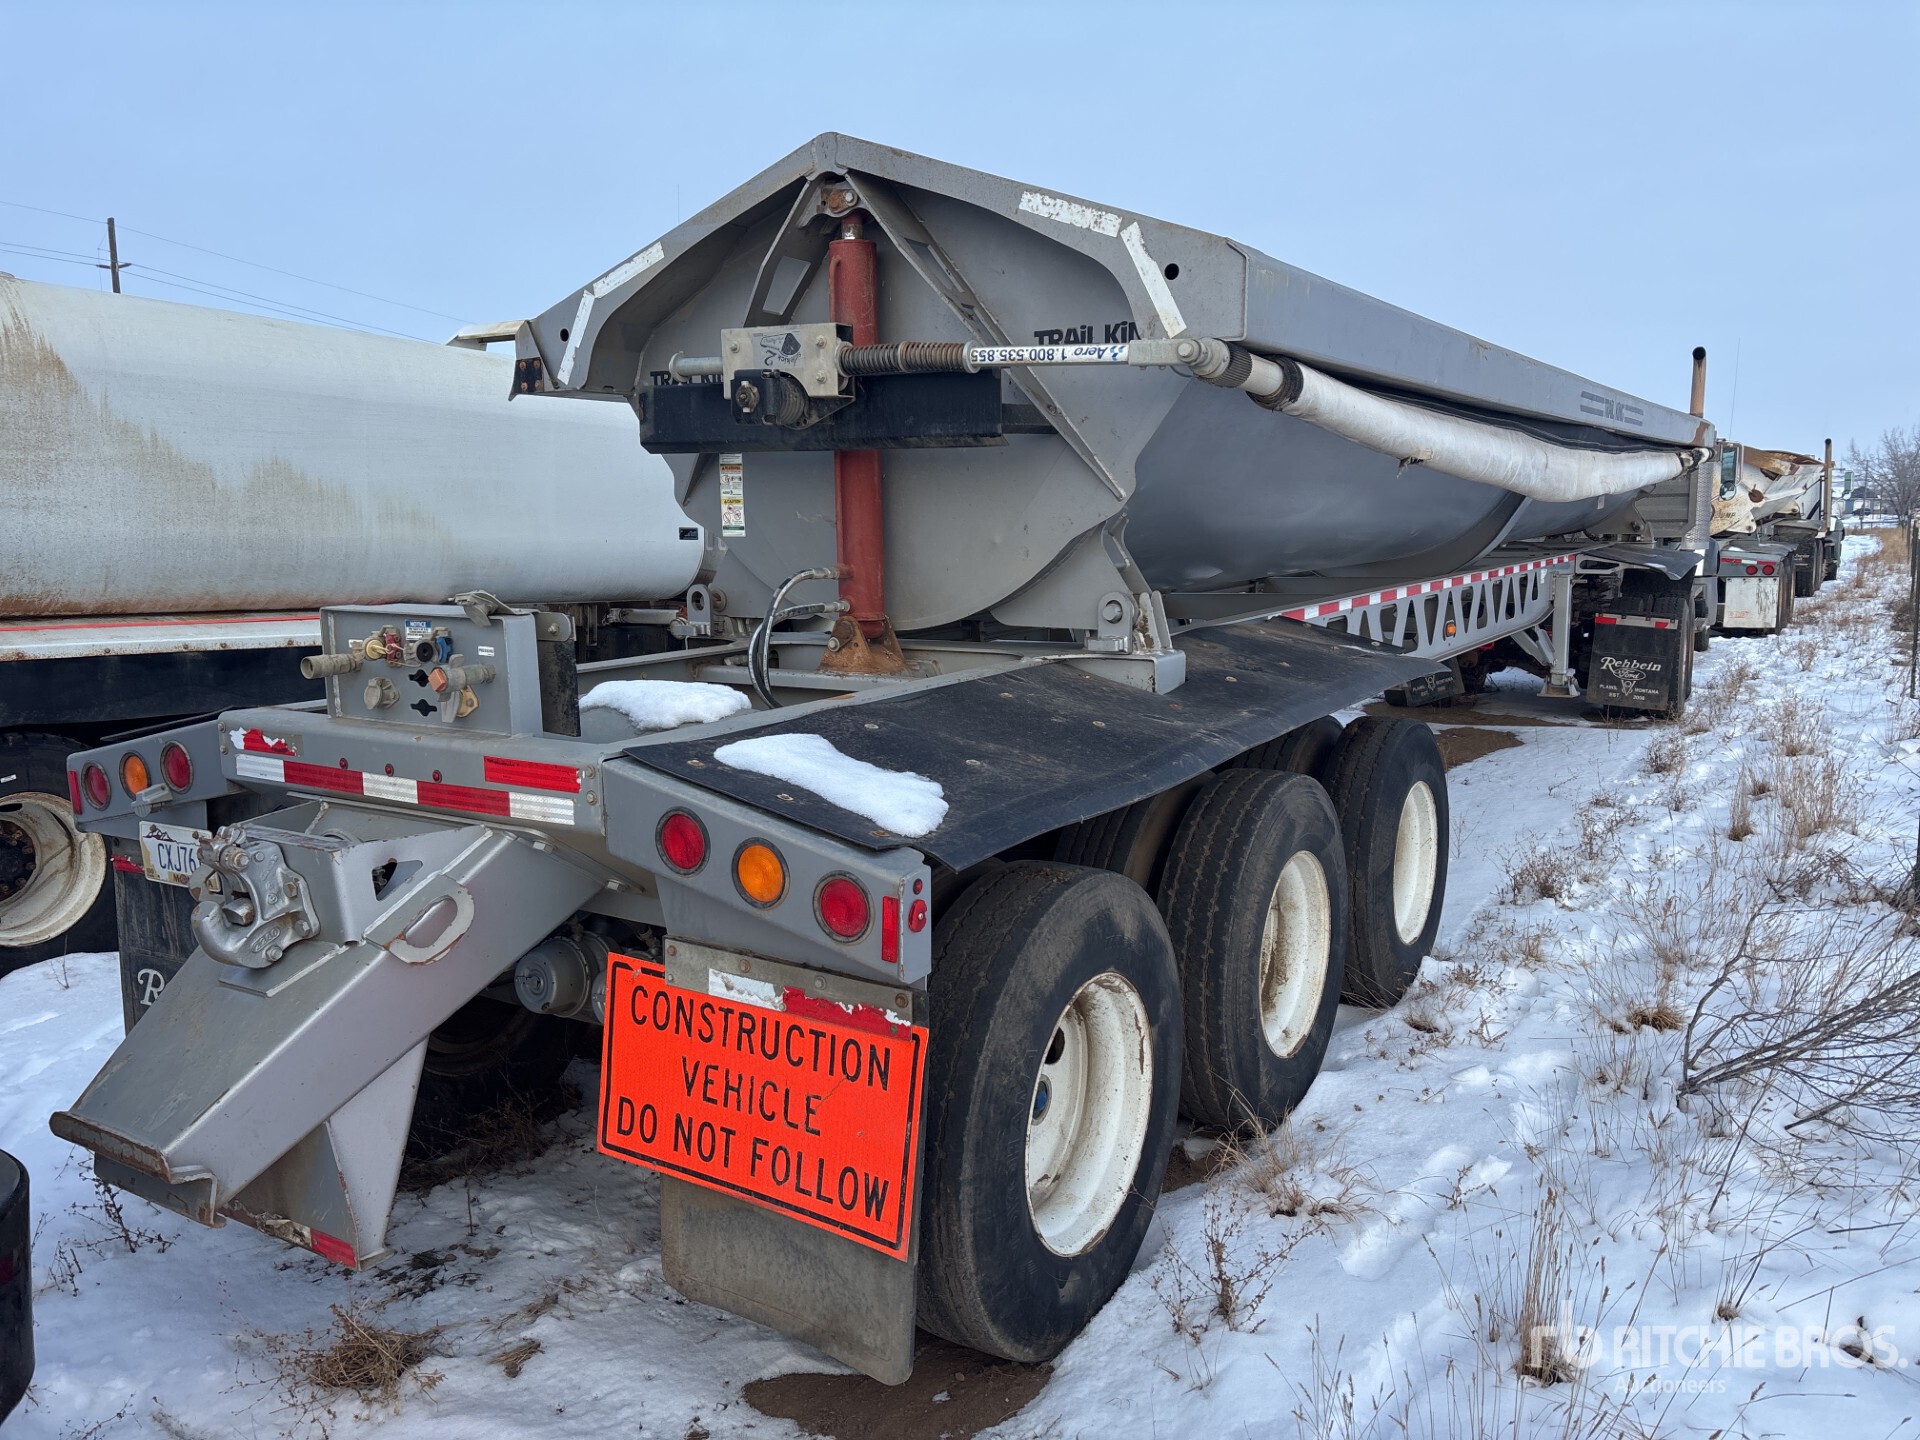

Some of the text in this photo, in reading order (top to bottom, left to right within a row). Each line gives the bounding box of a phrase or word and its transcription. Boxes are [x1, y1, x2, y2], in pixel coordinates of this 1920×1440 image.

[1070, 346, 1108, 360] Aero
[1600, 656, 1661, 672] Rehbein
[157, 843, 197, 873] CXJ76
[631, 984, 891, 1092] CONSTRUCTION
[681, 1055, 822, 1137] VEHICLE
[616, 1096, 890, 1222] DO NOT FOLLOW
